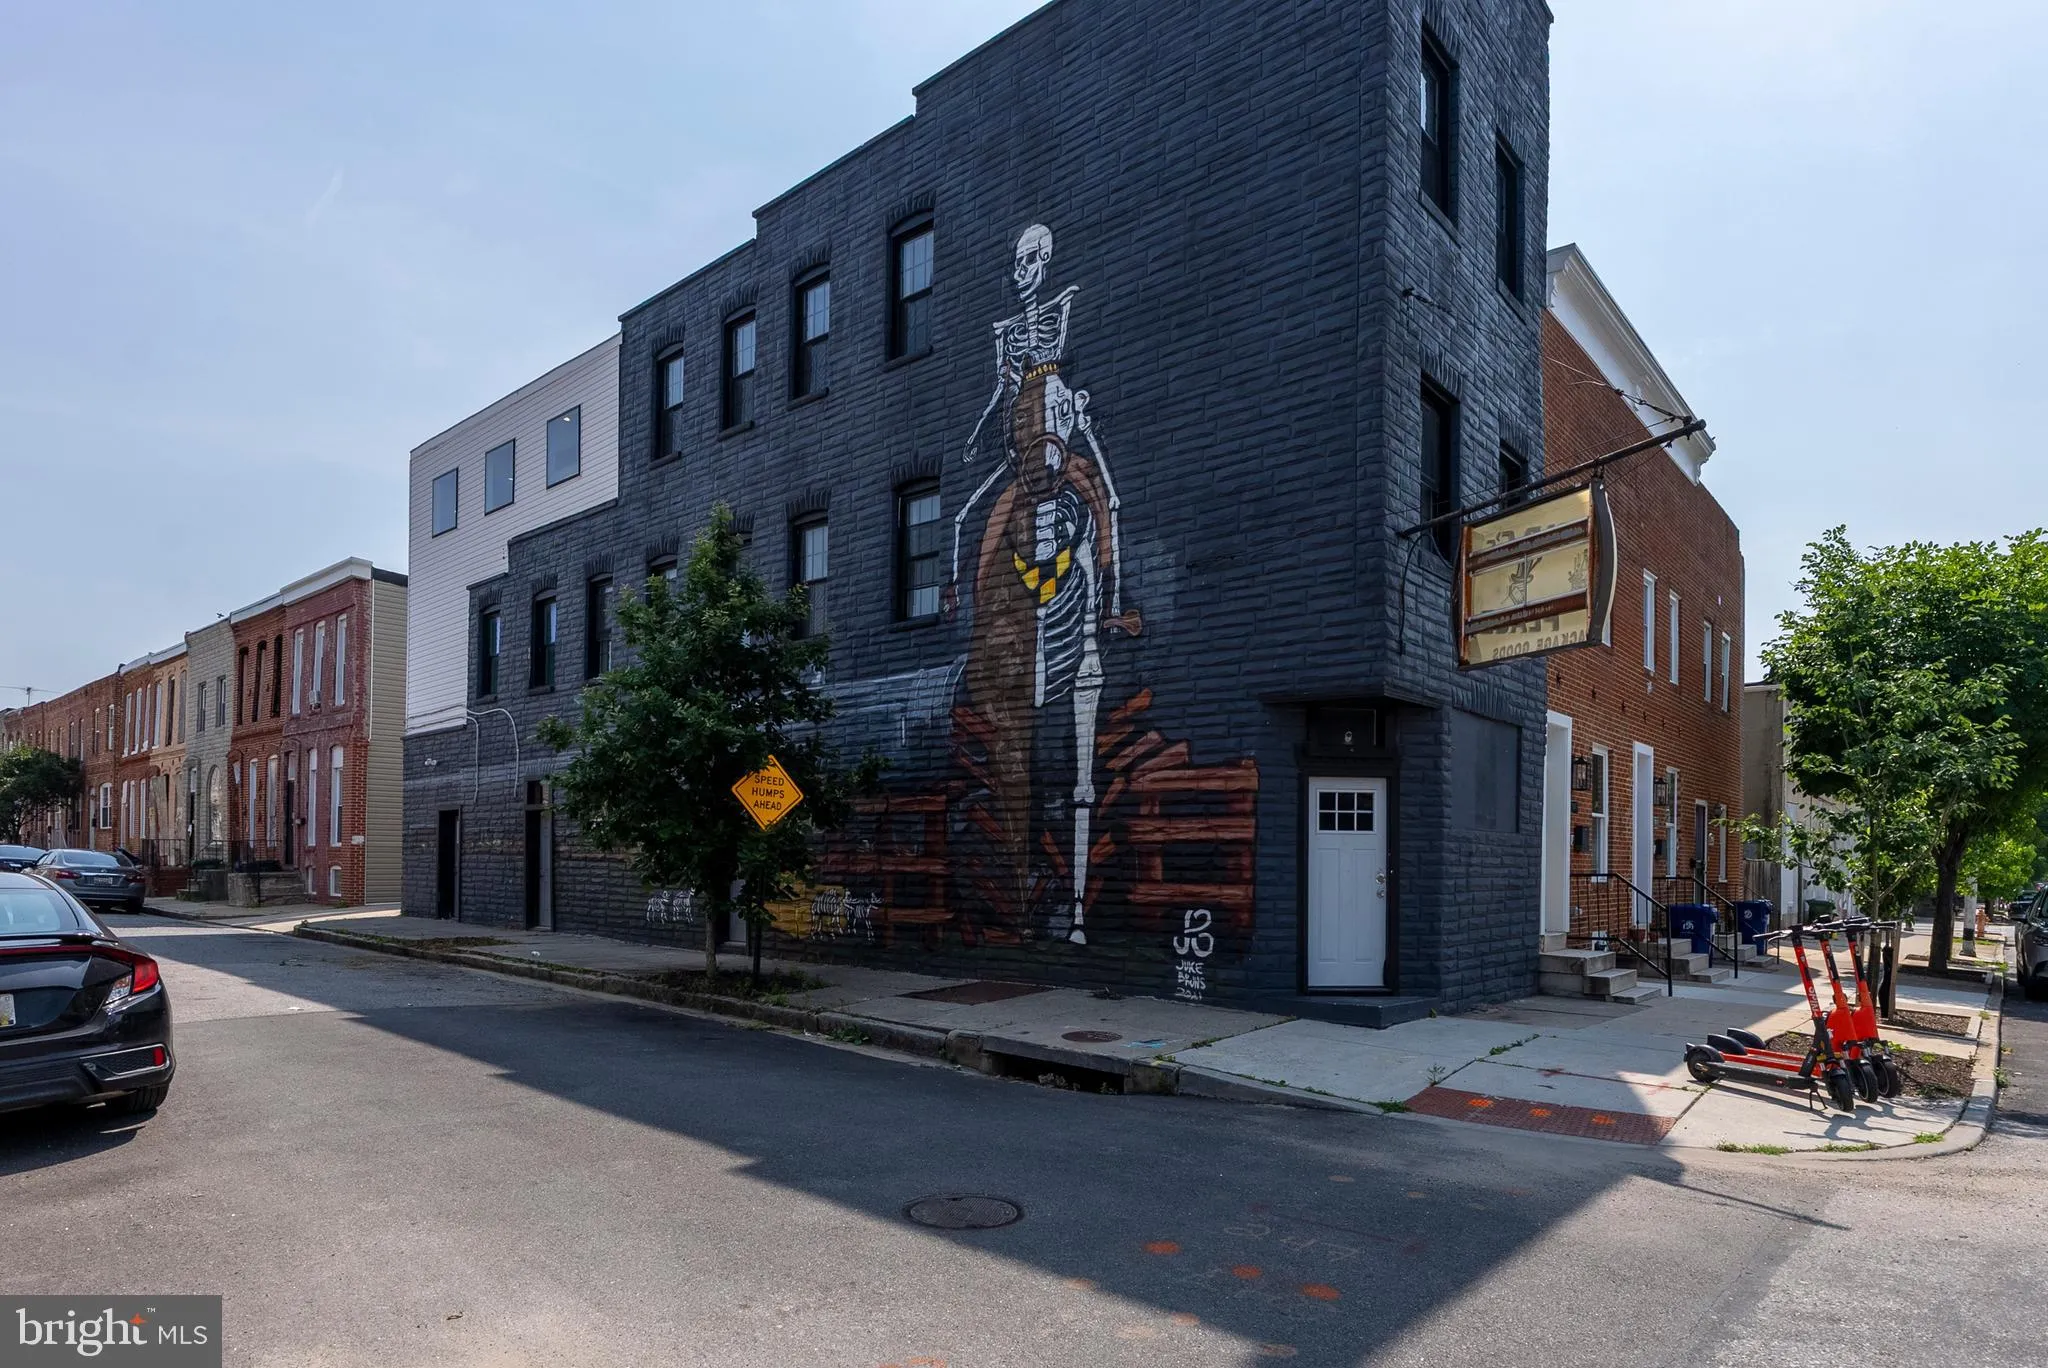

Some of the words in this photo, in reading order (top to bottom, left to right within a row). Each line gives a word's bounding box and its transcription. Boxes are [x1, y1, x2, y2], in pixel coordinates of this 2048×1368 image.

[754, 774, 785, 787] SPEED
[751, 787, 785, 799] HUMPS
[753, 799, 782, 811] AHEAD
